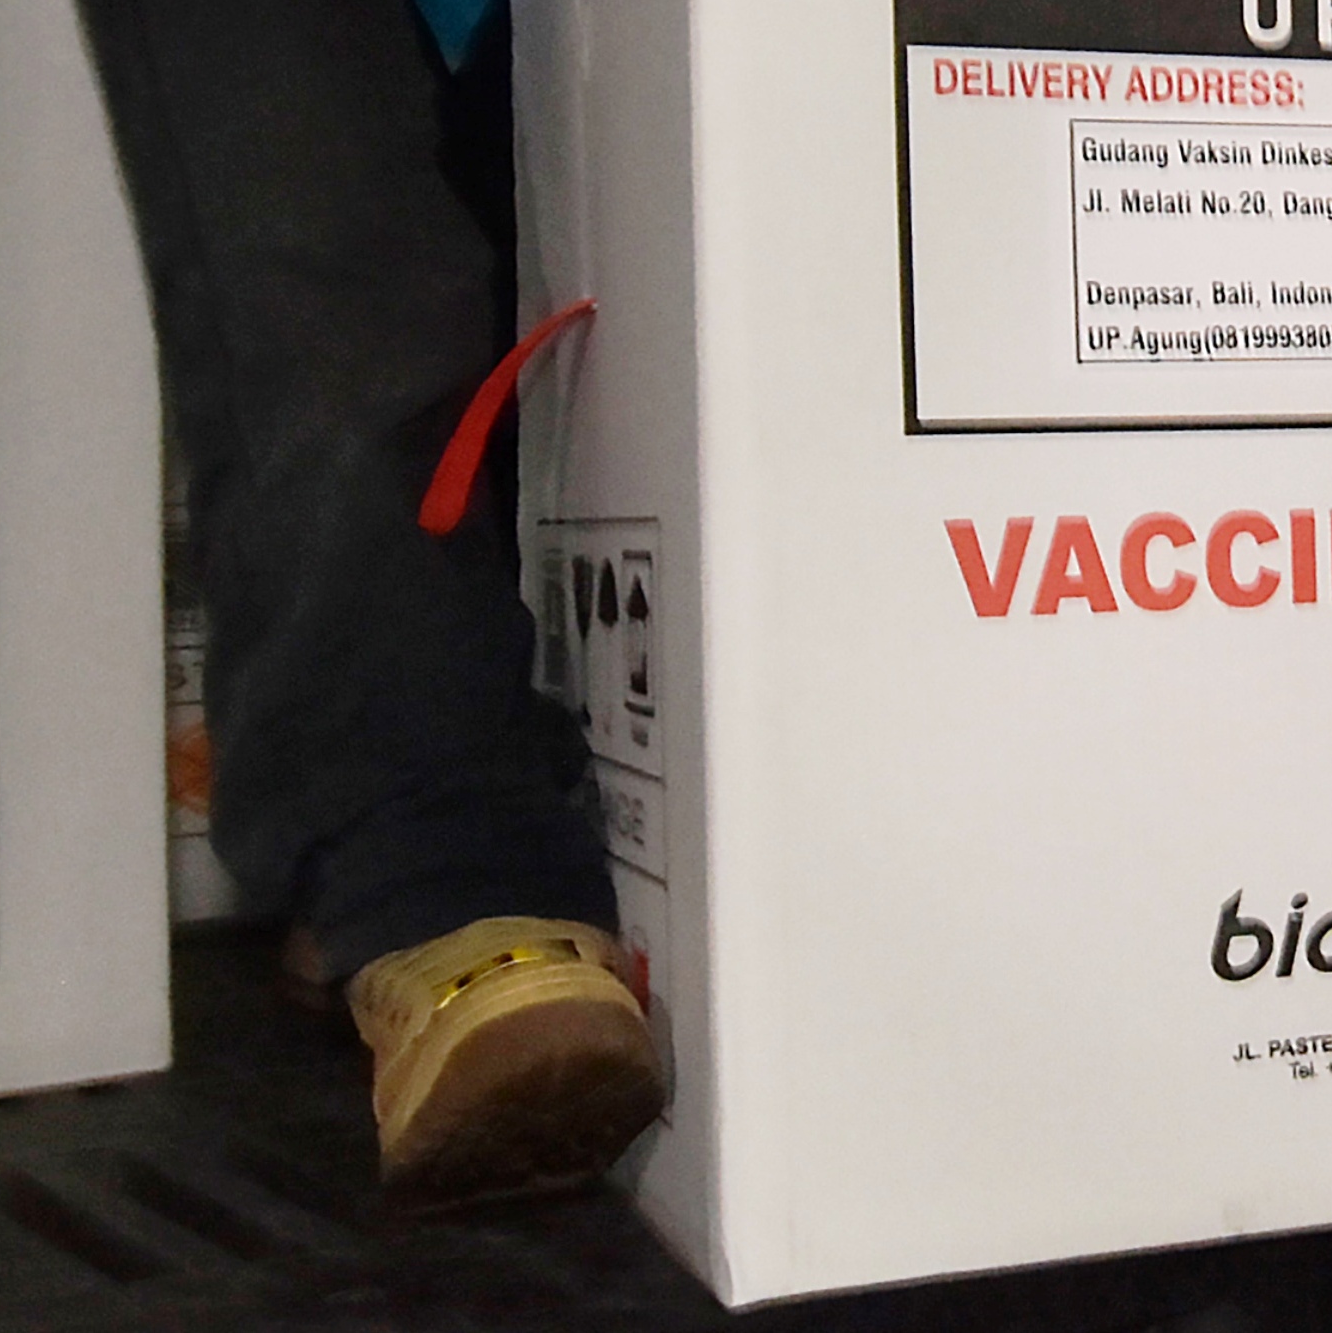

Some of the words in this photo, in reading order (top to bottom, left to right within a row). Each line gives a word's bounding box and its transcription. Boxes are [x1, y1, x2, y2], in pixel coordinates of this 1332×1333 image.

[933, 57, 1113, 101] DELIVERY
[1125, 65, 1306, 110] ADDRESS:
[1082, 137, 1168, 168] Gudang
[1178, 139, 1252, 166] Vaksin
[1121, 189, 1192, 215] Melati
[1087, 280, 1202, 310] Denpasar,
[1212, 281, 1262, 308] Bali,
[1233, 1043, 1261, 1061] JL.
